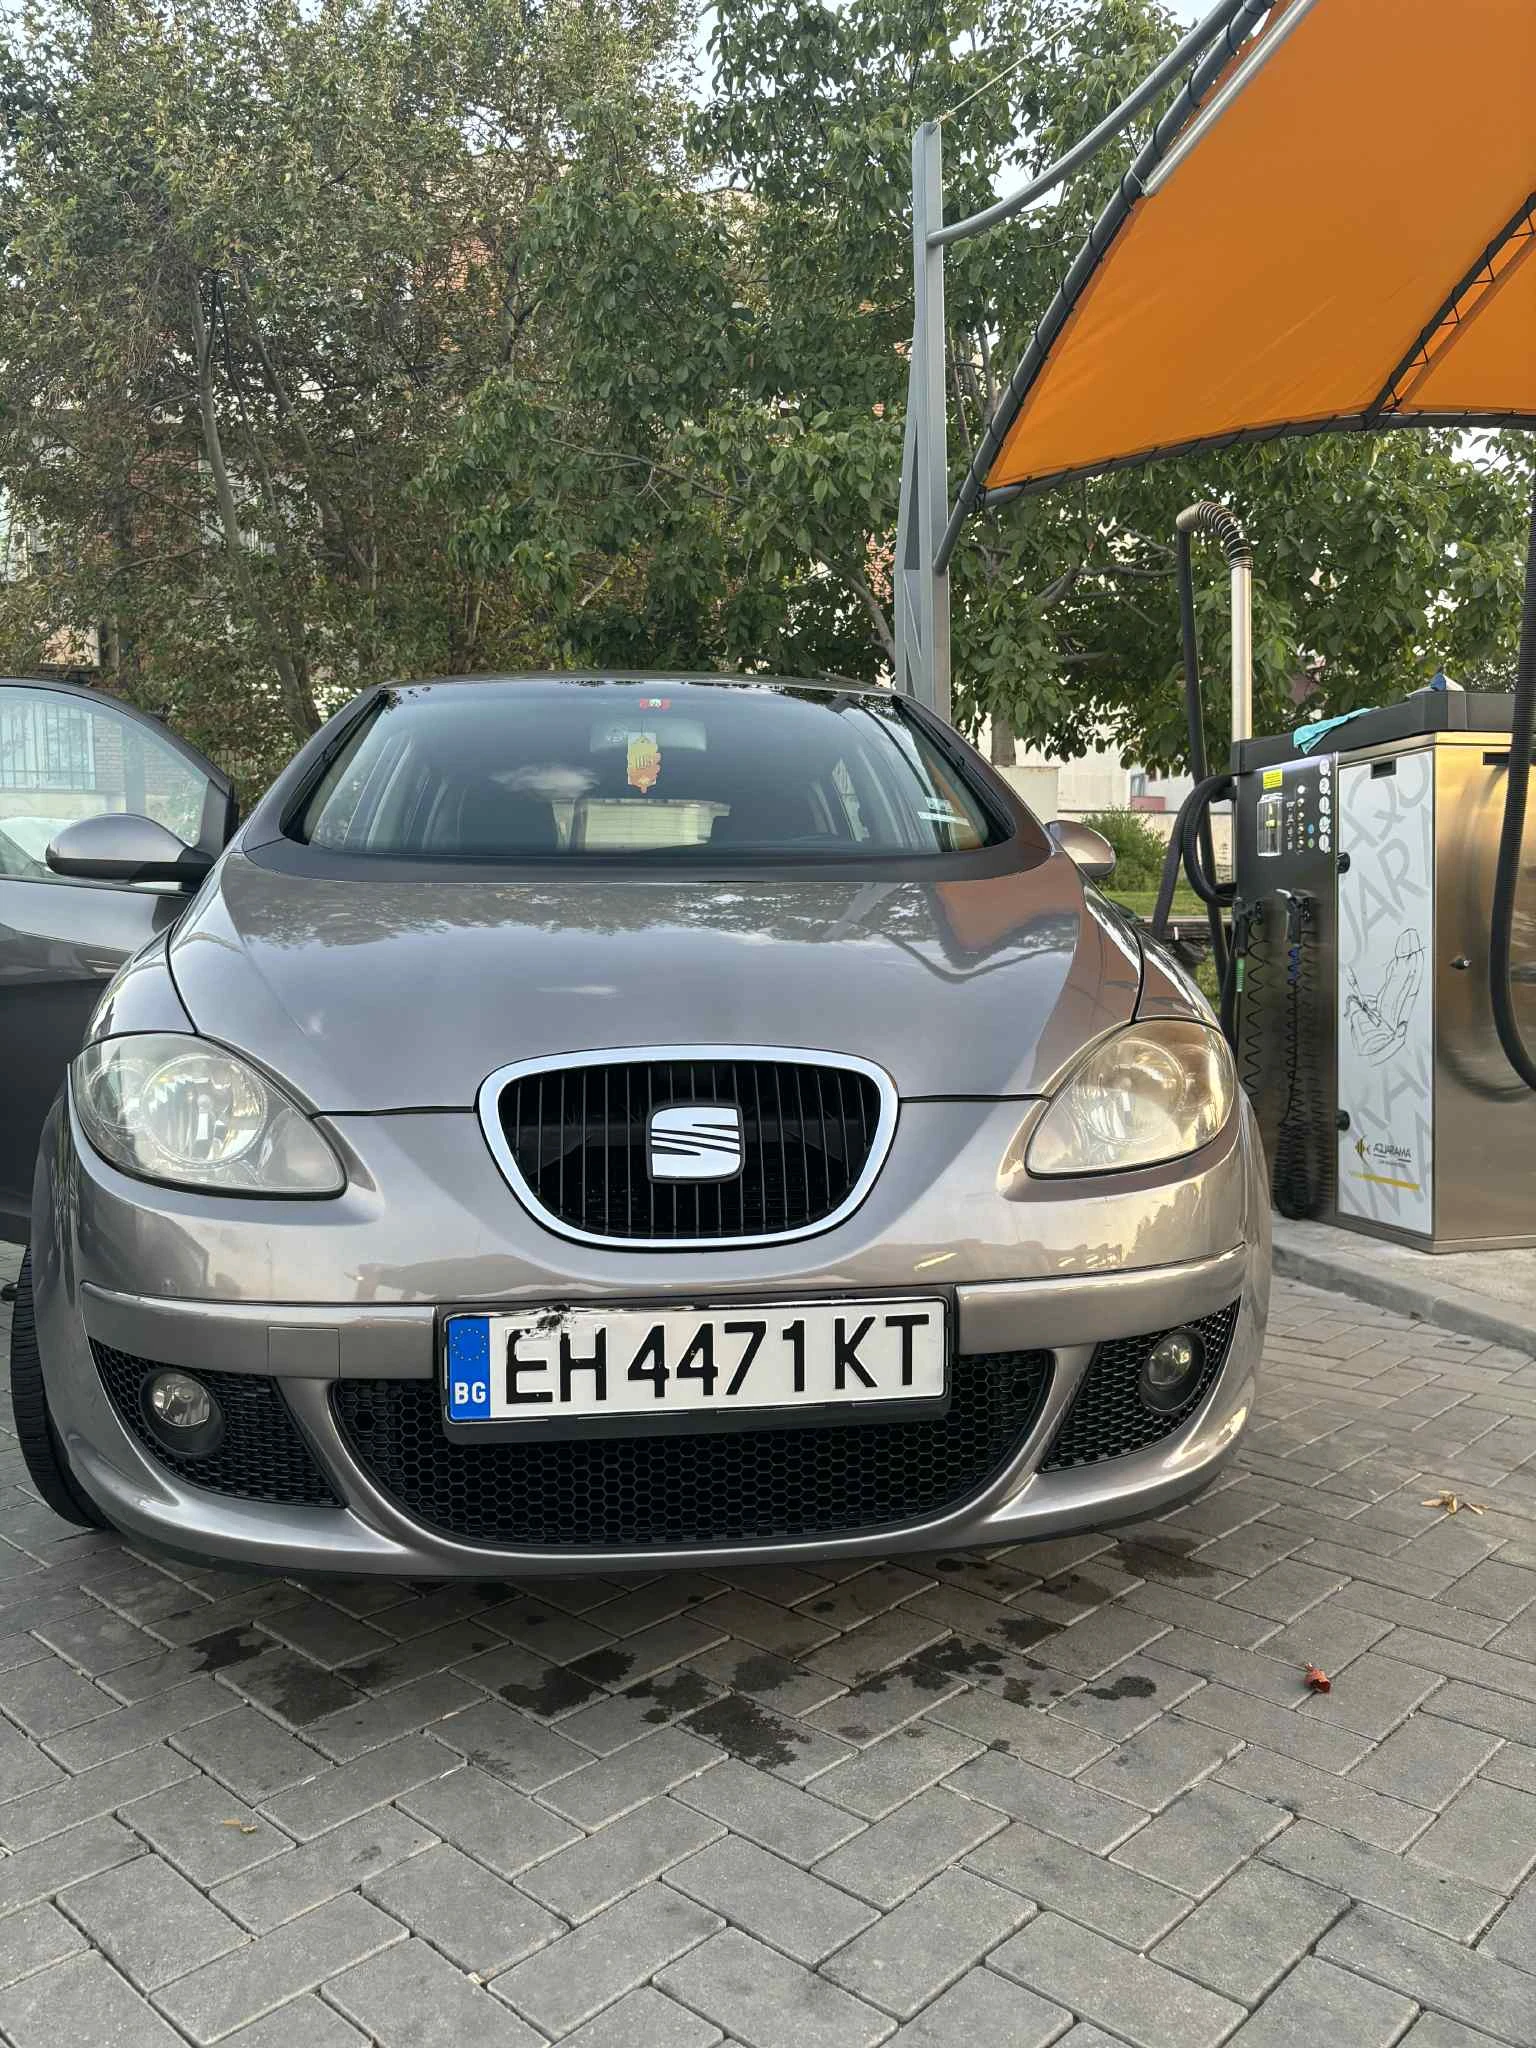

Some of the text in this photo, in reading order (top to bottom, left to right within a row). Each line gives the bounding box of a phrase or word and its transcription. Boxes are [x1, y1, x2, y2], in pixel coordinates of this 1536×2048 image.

[505, 1313, 930, 1405] EH 4471 KT
[453, 1381, 487, 1405] BG
